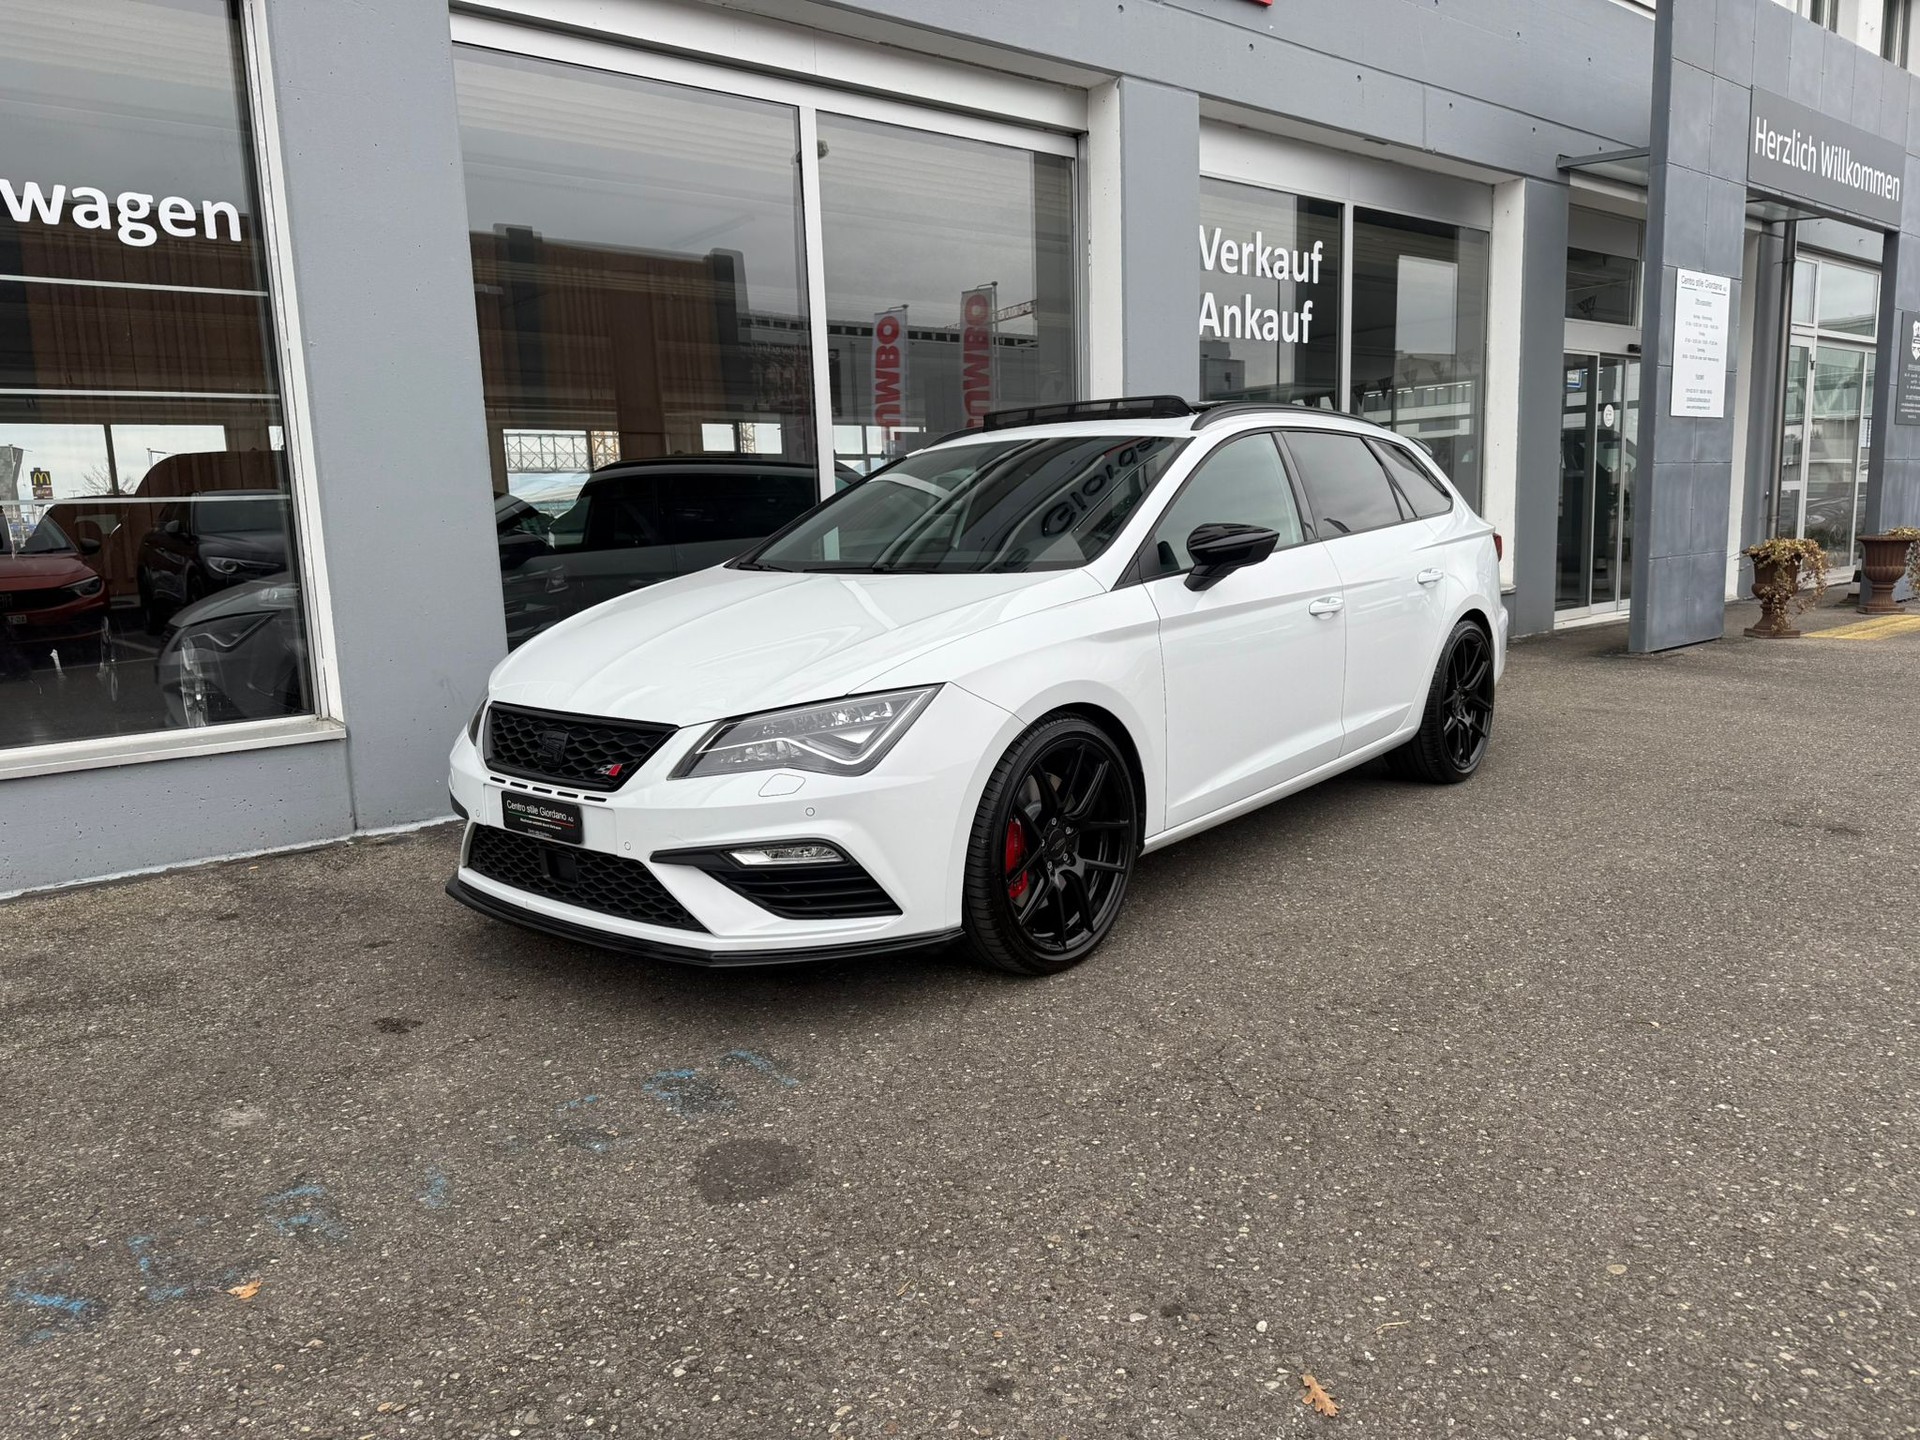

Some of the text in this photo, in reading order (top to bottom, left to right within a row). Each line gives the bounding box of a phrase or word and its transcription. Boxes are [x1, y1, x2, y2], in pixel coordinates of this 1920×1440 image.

[1755, 116, 1901, 201] Herzlich Willkommen
[0, 178, 242, 247] wagen
[1199, 224, 1323, 284] Verkauf
[1199, 292, 1313, 344] Ankauf
[506, 799, 526, 812] Centro
[526, 804, 539, 815] stile
[539, 806, 567, 821] Giordano
